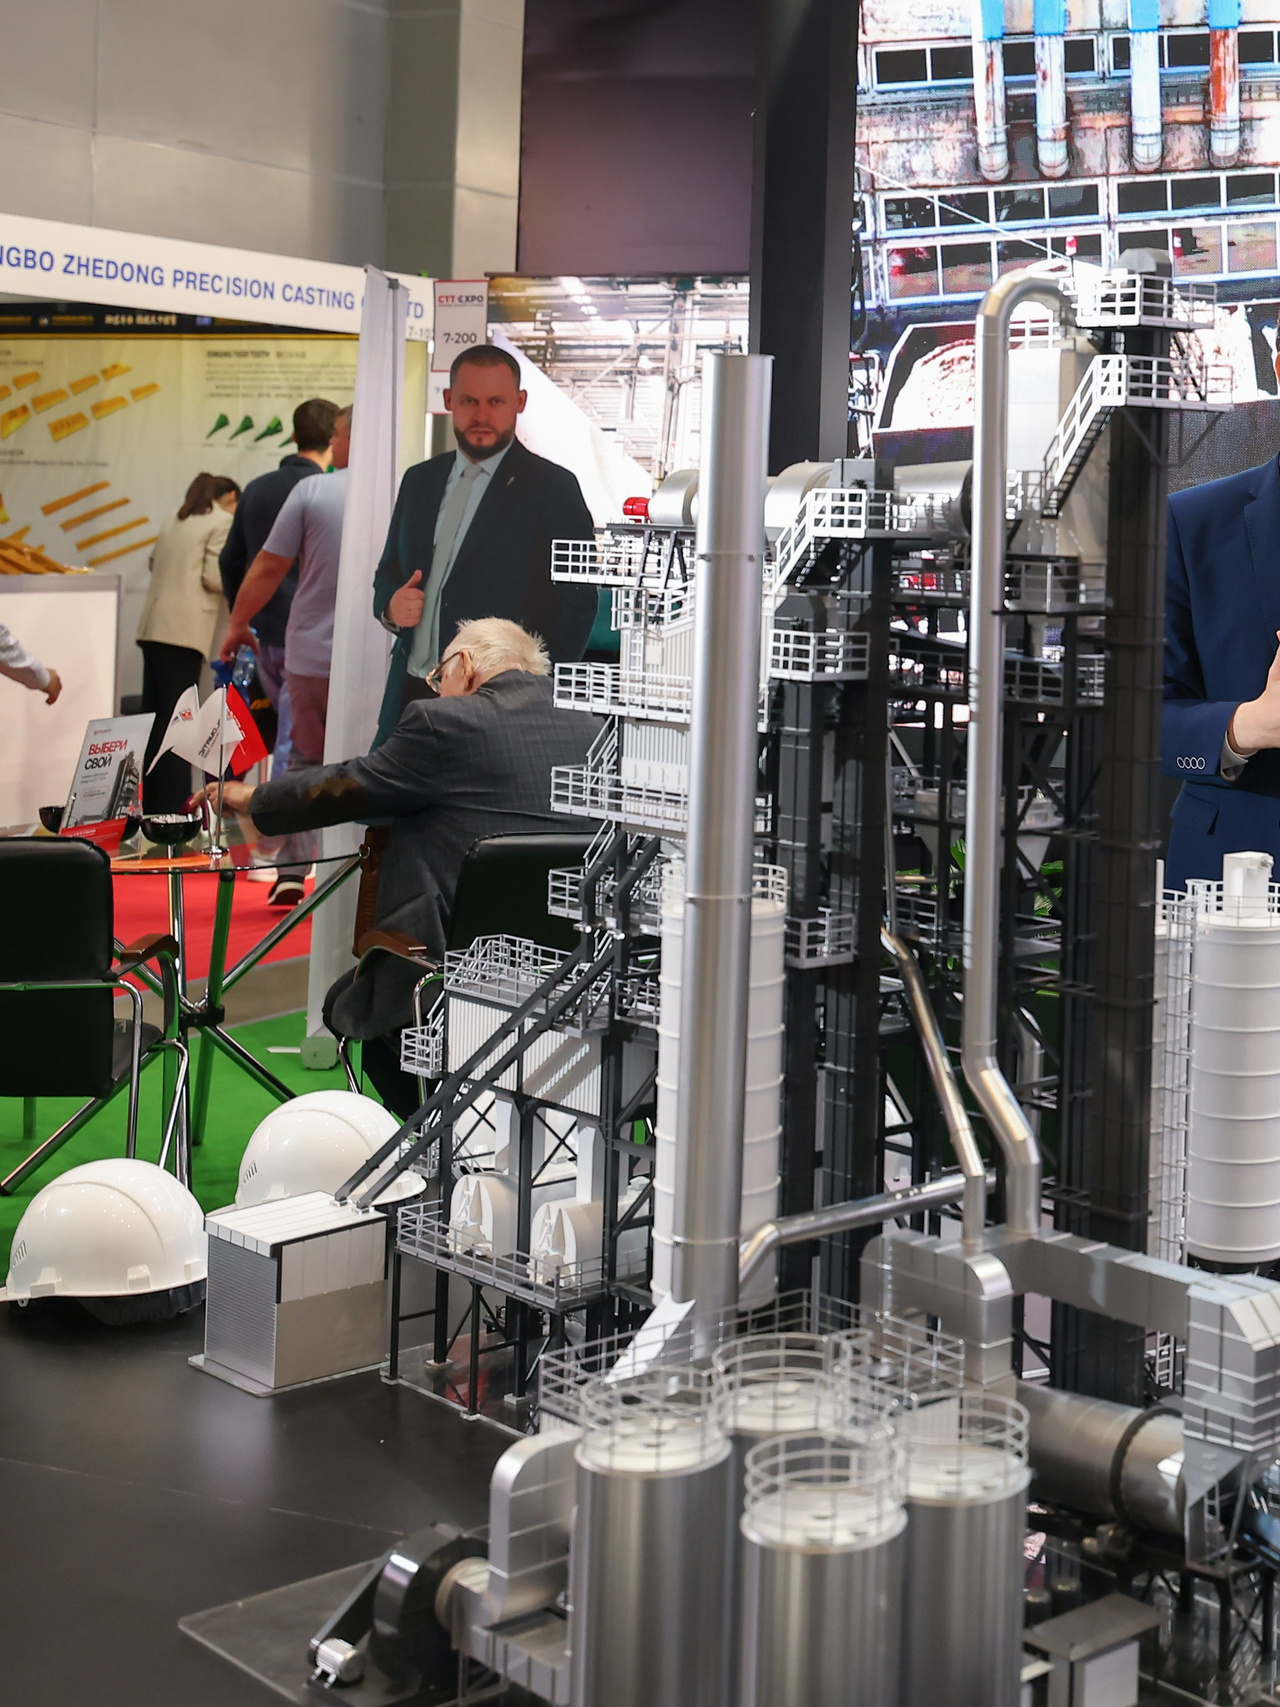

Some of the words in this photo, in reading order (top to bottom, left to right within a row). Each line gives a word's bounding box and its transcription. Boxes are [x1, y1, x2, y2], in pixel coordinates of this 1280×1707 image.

[0, 245, 54, 271] GBO
[62, 254, 164, 286] ZHEDONG
[172, 269, 275, 300] PRECISION
[282, 283, 355, 310] CASTING
[406, 301, 424, 319] TD
[438, 295, 456, 303] CTT
[457, 295, 484, 303] EXPO
[443, 332, 477, 344] 7-200
[88, 739, 128, 756] ВЫБЕРИ
[84, 754, 113, 770] СВОЙ
